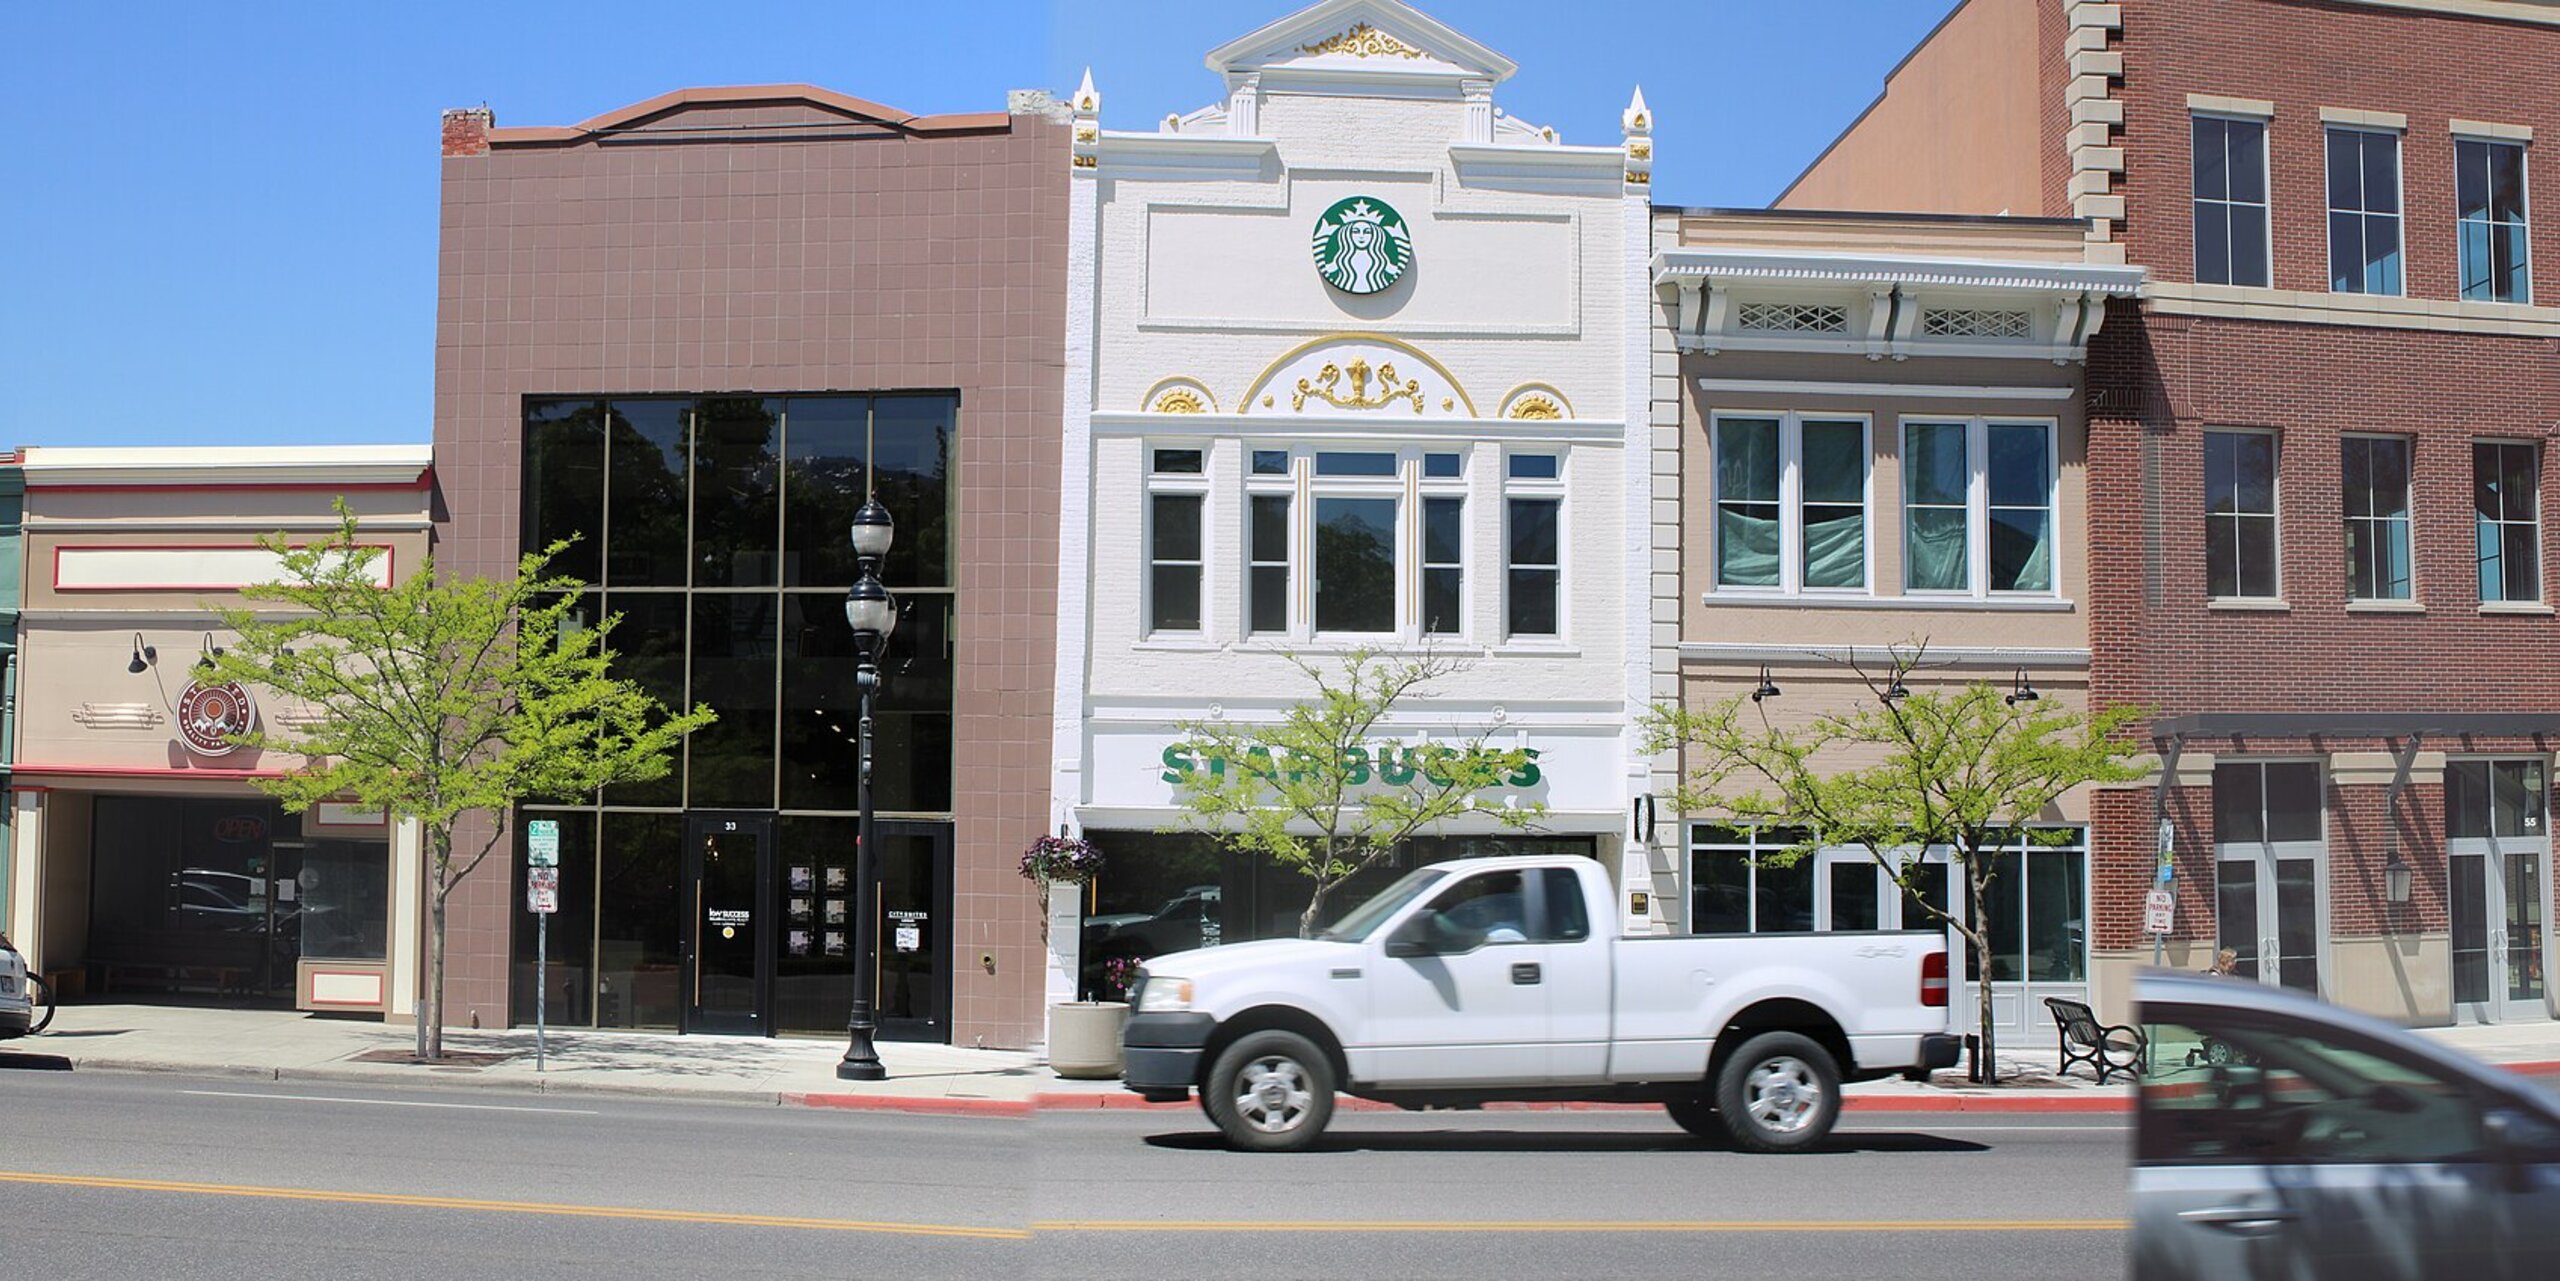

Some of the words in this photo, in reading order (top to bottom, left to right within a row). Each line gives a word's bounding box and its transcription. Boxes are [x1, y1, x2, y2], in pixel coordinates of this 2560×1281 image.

[724, 821, 737, 831] 33
[2524, 817, 2537, 827] 55
[215, 817, 262, 841] OPEN
[2156, 894, 2167, 903] NO
[2149, 903, 2173, 912] PARKING
